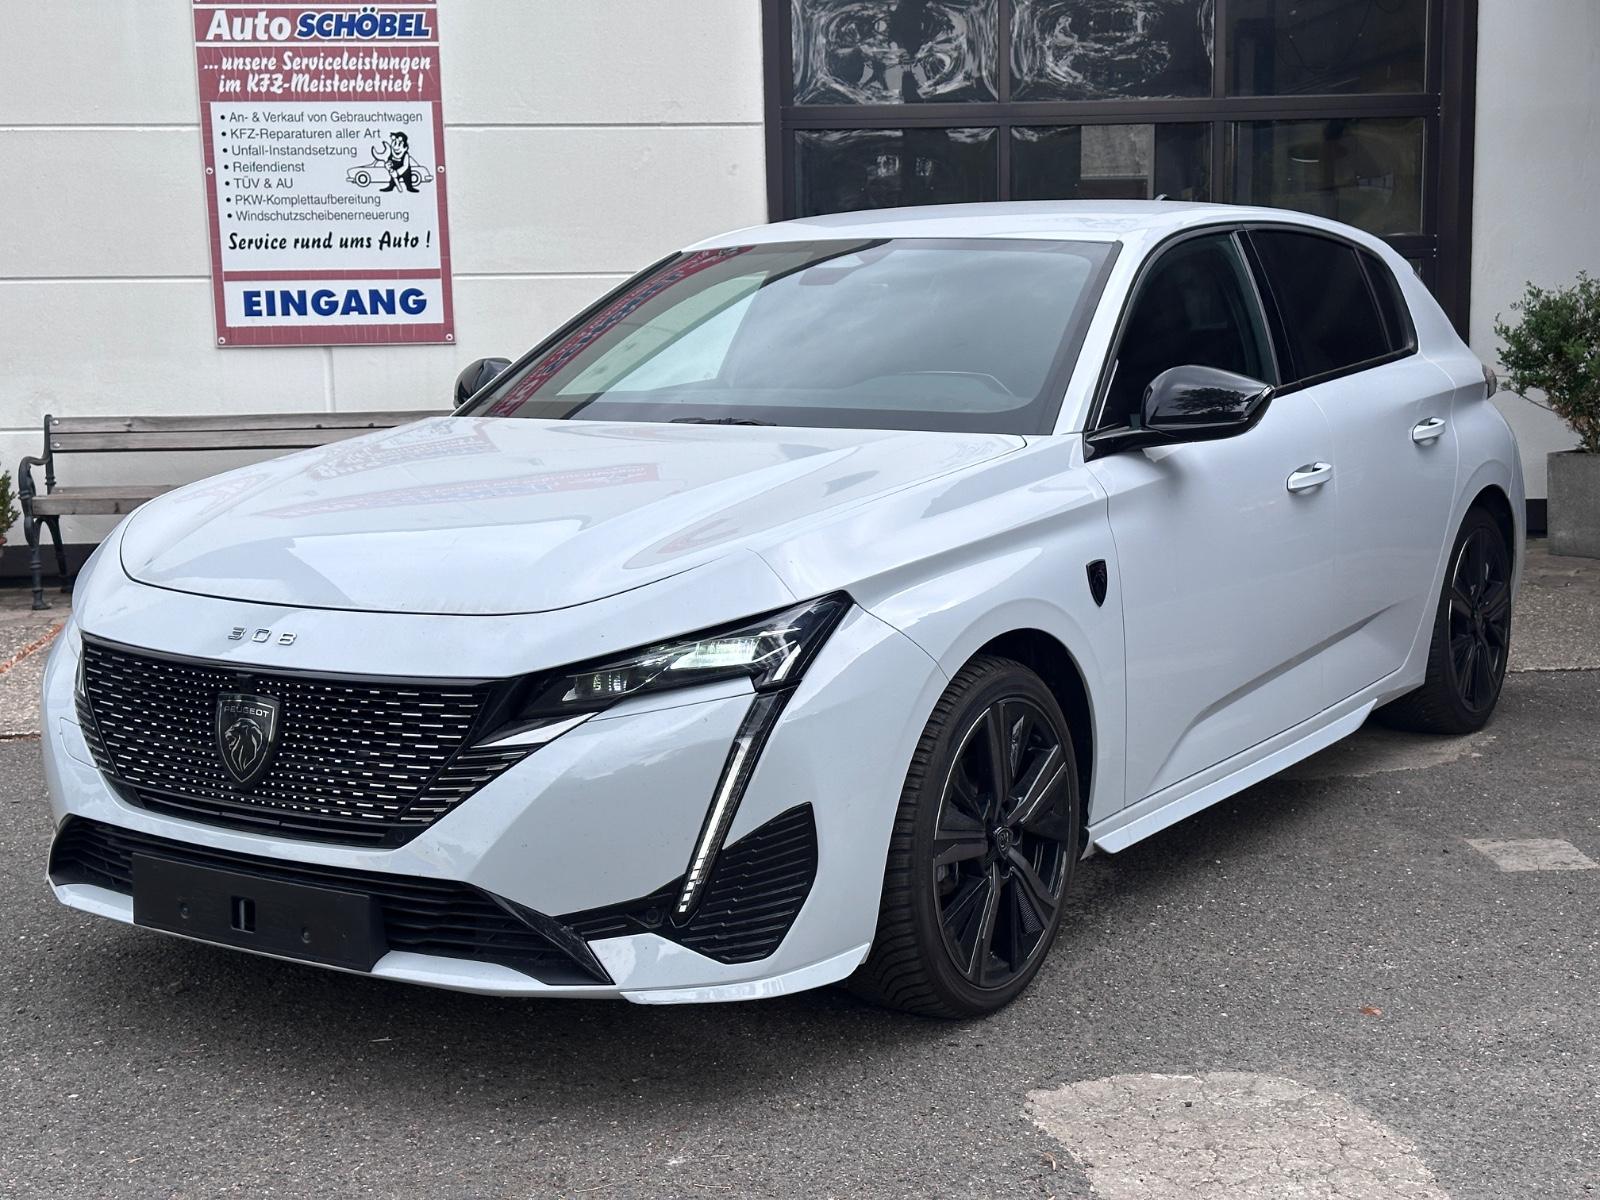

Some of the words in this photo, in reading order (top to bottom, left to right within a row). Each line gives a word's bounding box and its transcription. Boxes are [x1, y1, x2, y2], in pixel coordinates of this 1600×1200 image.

[206, 10, 291, 41] Auto
[297, 7, 430, 38] SCHÖBEL
[282, 50, 431, 72] Serviceleistungen
[219, 76, 241, 92] im
[246, 73, 412, 94] KFZ-Meisterbetrieb
[229, 112, 248, 123] An-
[252, 112, 260, 122] &
[263, 111, 305, 122] Verkauf
[308, 114, 327, 122] von
[330, 111, 423, 124] Gebrauchtwagen
[230, 128, 332, 141] KFZ-Reparaturen
[335, 128, 361, 139] aller
[363, 128, 382, 139] Art
[231, 144, 358, 158] Unfall-Instandsetzung
[232, 160, 305, 173] Reifendienst
[233, 175, 260, 189] TÜV
[264, 178, 273, 189] &
[276, 177, 293, 189] AU
[235, 193, 381, 207] PKW-Komplettaufbereitung
[235, 209, 409, 223] Windschutzscheibenerneuerung
[228, 232, 287, 250] Service
[293, 231, 333, 250] rund
[339, 237, 372, 249] ums
[378, 230, 419, 251] Auto
[243, 287, 427, 317] EINGANG
[228, 627, 297, 646] 308
[223, 705, 269, 718] PEUGEOT
